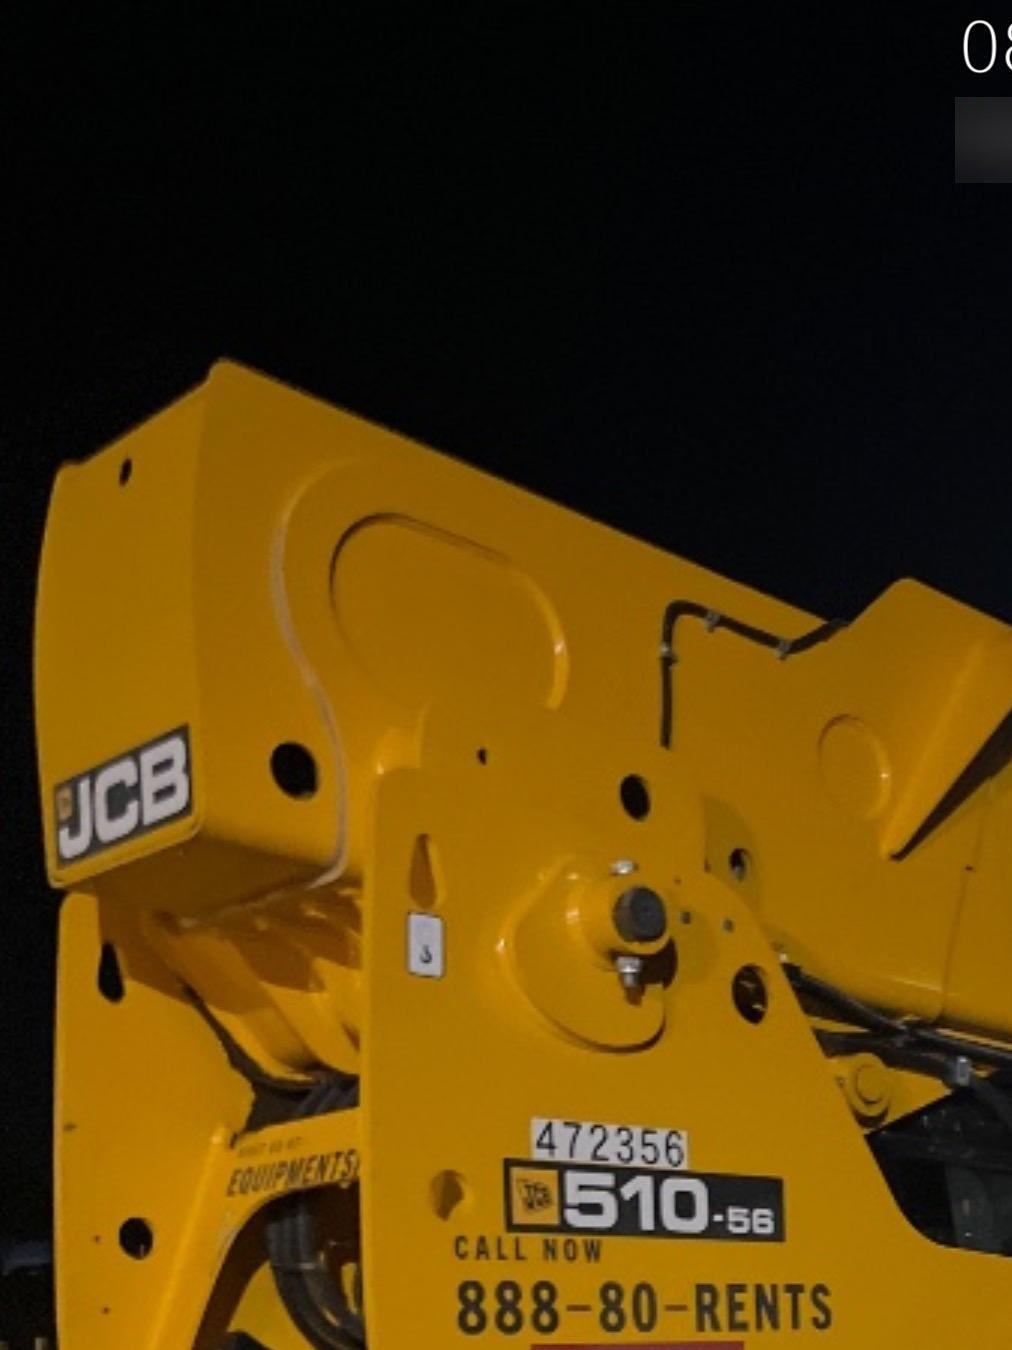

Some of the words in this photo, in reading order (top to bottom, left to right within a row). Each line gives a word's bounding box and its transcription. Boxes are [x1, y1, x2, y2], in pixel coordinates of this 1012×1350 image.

[57, 735, 190, 860] JCB
[536, 1120, 685, 1168] 472356
[226, 1148, 359, 1197] EQUIPMENTS
[454, 1234, 527, 1261] CALL
[542, 1238, 601, 1263] NOW
[458, 1280, 832, 1335] 888-80-RENTS
